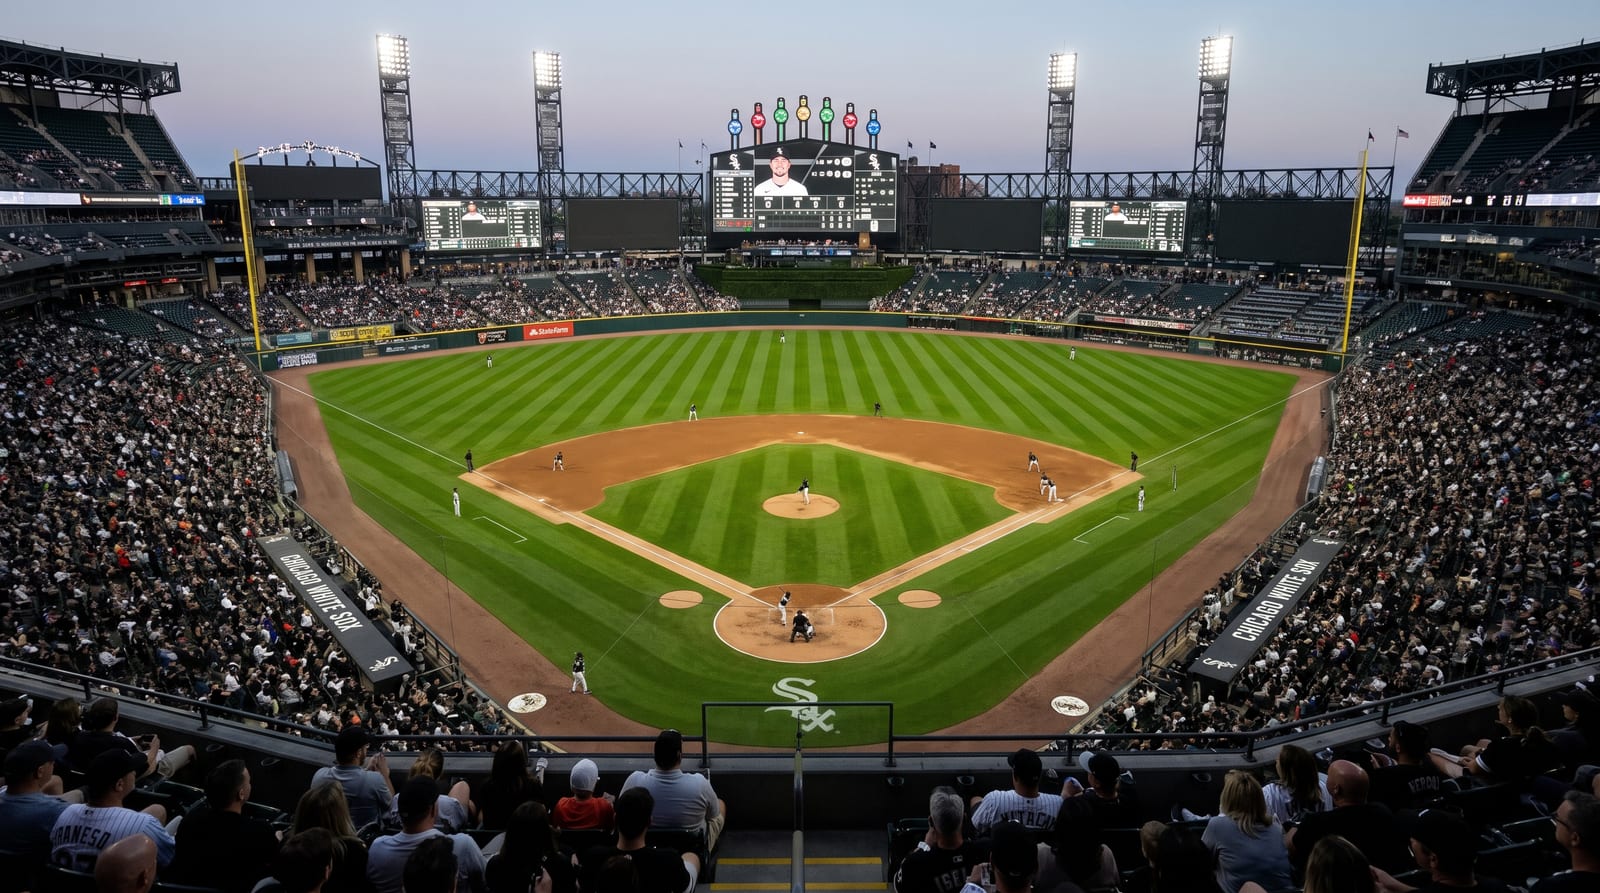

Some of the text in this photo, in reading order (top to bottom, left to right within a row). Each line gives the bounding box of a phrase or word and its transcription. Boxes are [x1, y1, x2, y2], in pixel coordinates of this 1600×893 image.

[280, 554, 363, 633] CHICAGO WHITE SOX
[1231, 558, 1320, 642] CHICAGO WHITE SOX
